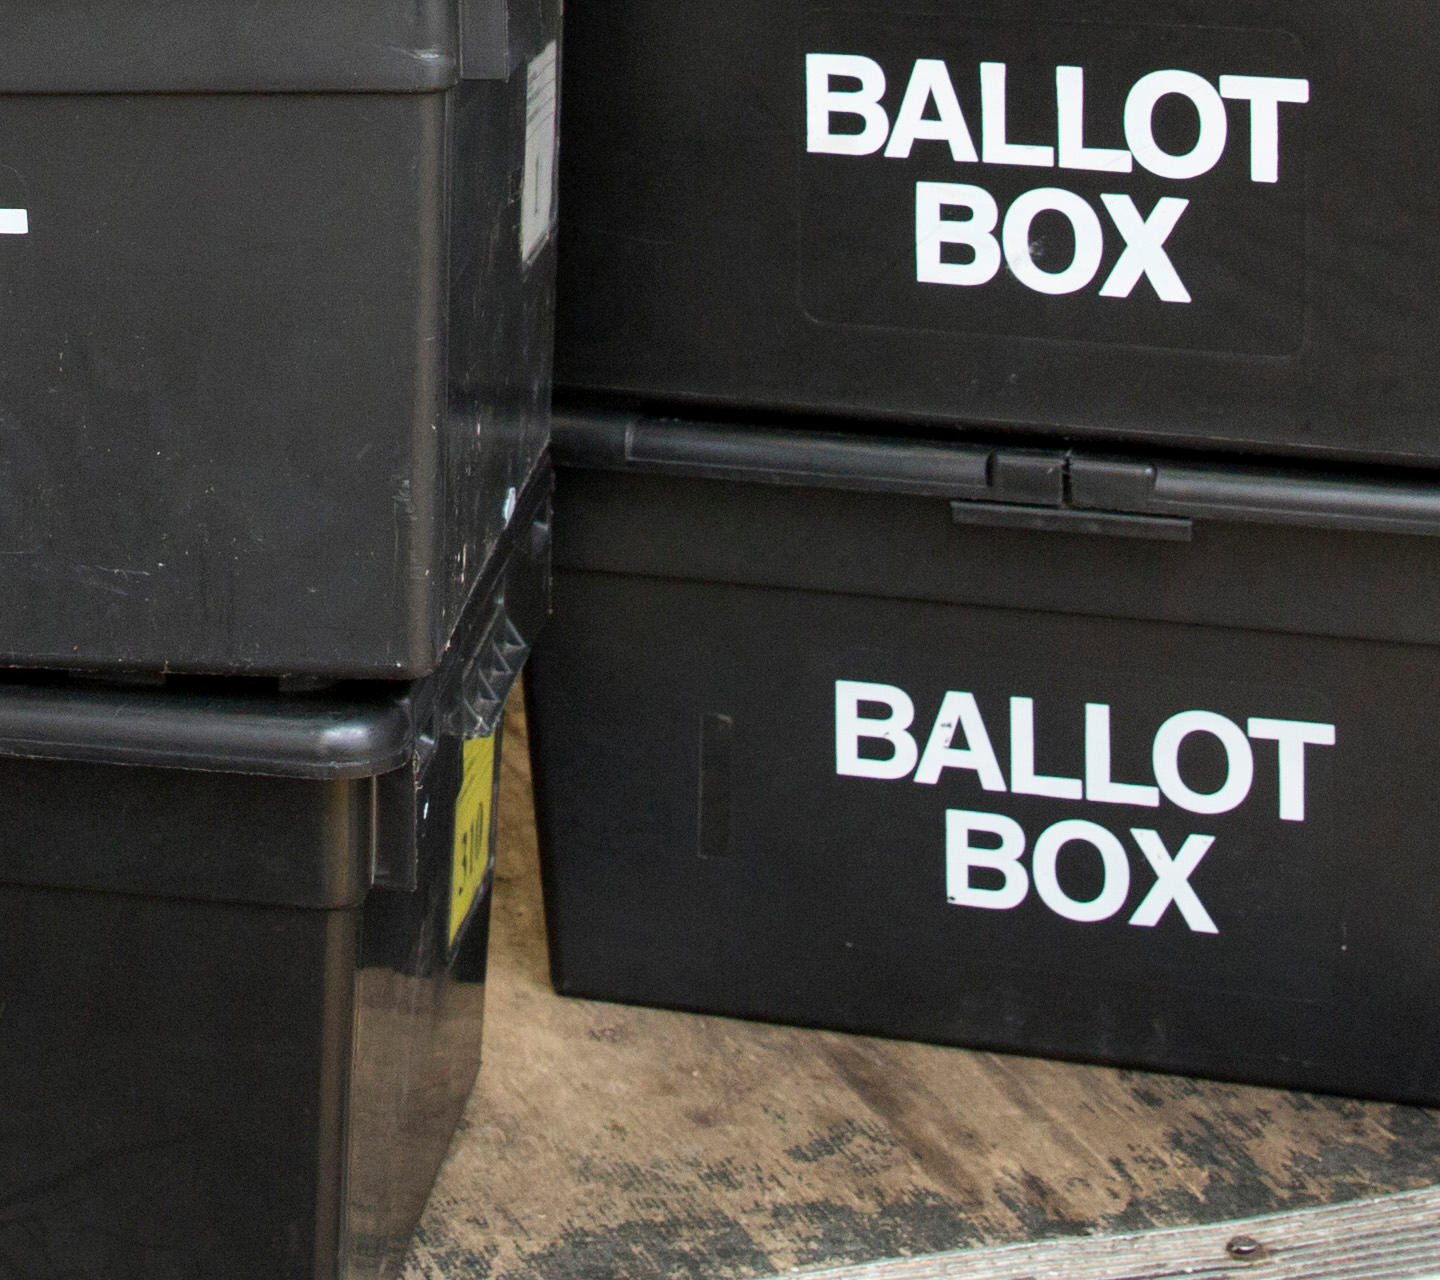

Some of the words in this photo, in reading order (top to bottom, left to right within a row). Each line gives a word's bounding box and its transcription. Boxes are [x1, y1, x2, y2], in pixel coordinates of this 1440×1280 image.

[806, 54, 1309, 183] BALLOT
[916, 181, 1191, 303] BOX
[836, 680, 1335, 821] BALLOT
[946, 809, 1218, 933] BOX
